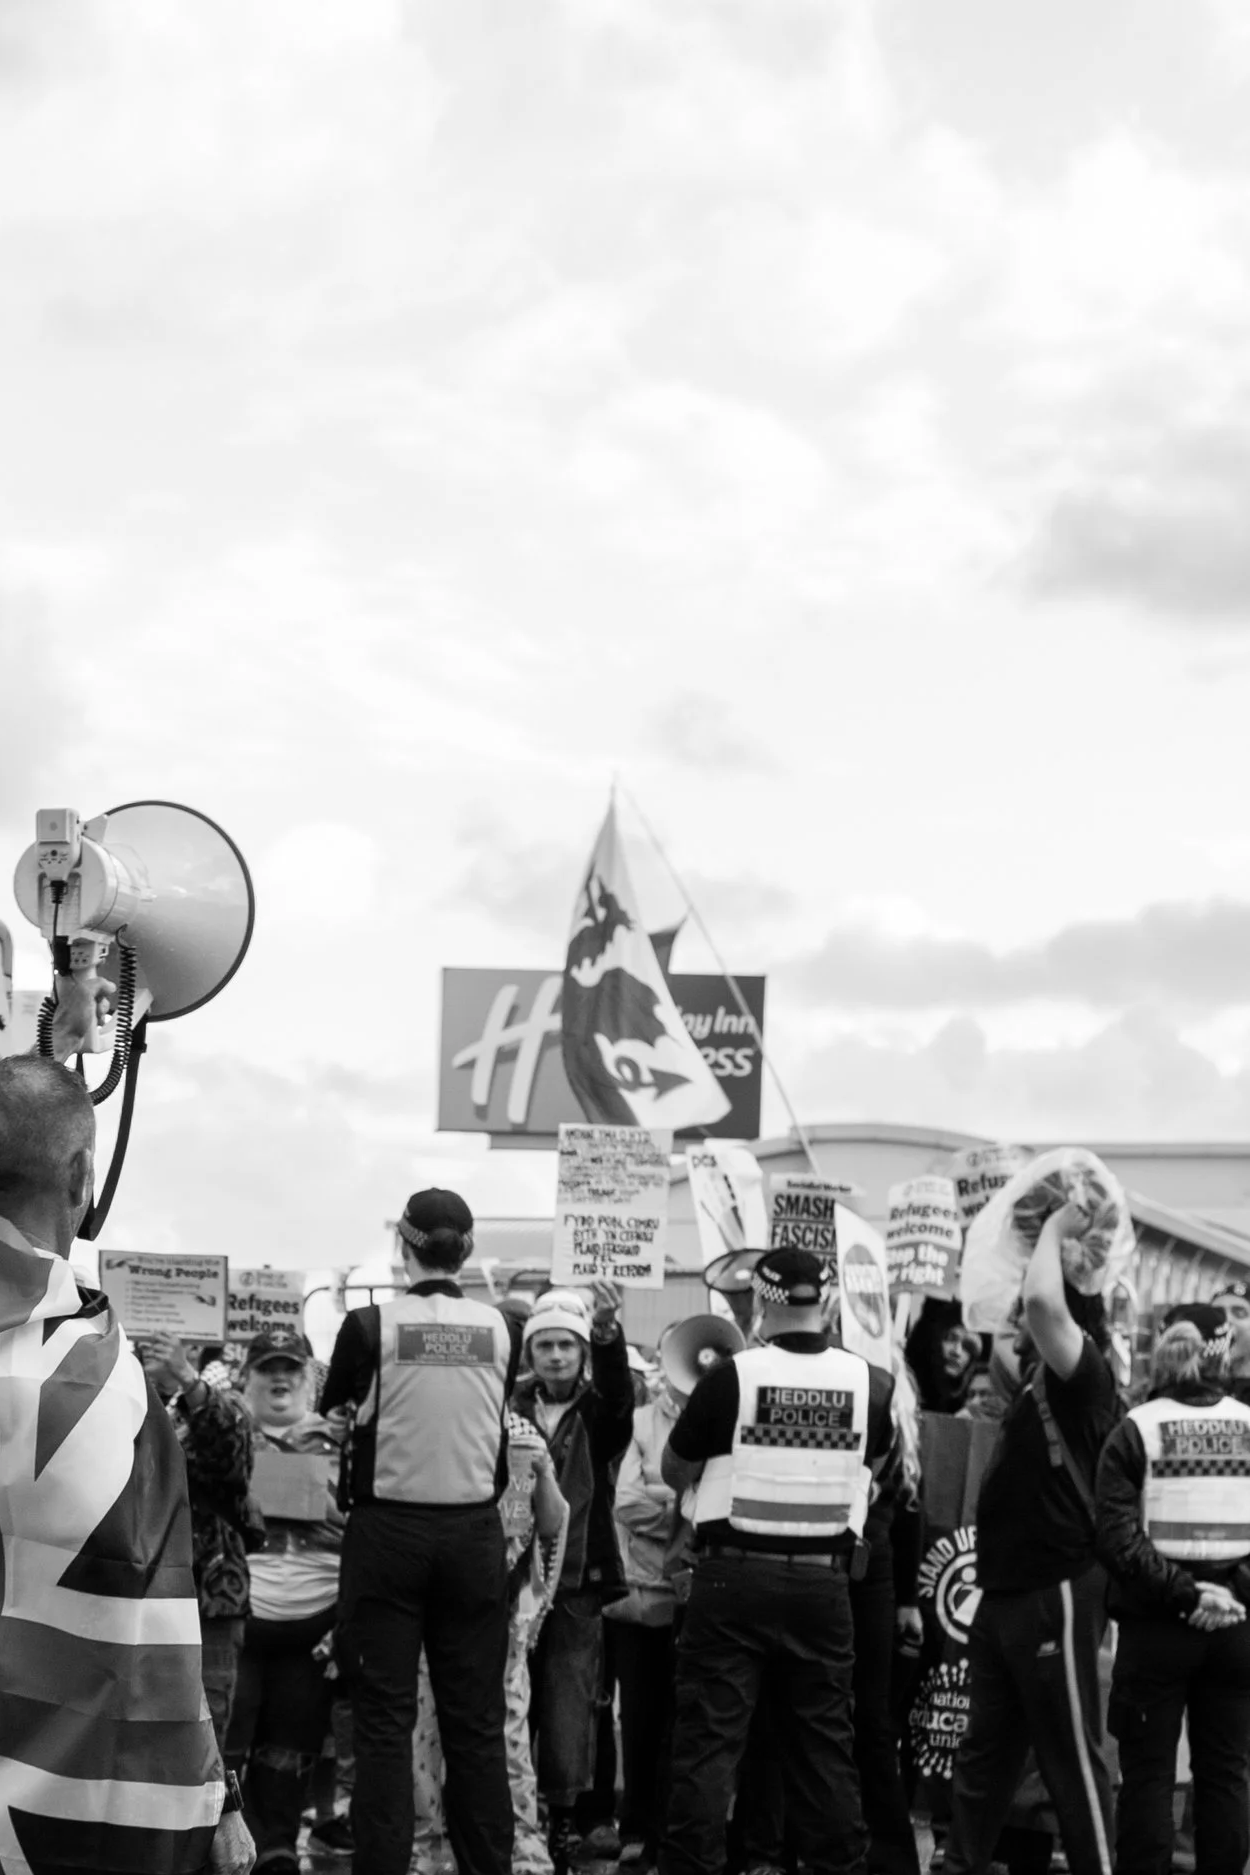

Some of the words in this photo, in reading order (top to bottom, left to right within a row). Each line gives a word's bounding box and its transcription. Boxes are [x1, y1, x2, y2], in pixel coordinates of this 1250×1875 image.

[714, 1005, 755, 1034] Inn
[773, 1194, 836, 1219] SMASH
[890, 1202, 958, 1221] Refugees
[887, 1222, 954, 1239] welcome
[917, 1244, 948, 1267] the
[129, 1265, 172, 1279] Wrong
[175, 1267, 219, 1281] People
[901, 1263, 944, 1286] right
[228, 1293, 300, 1316] Refugees
[228, 1315, 296, 1332] welcome
[425, 1343, 469, 1355] POLICE
[767, 1389, 846, 1408] HEDDLU
[770, 1408, 840, 1427] POLICE
[1168, 1420, 1244, 1436] HEDDLU
[1175, 1436, 1243, 1454] POLICE
[918, 1537, 956, 1598] STAND
[908, 1708, 969, 1732] educa
